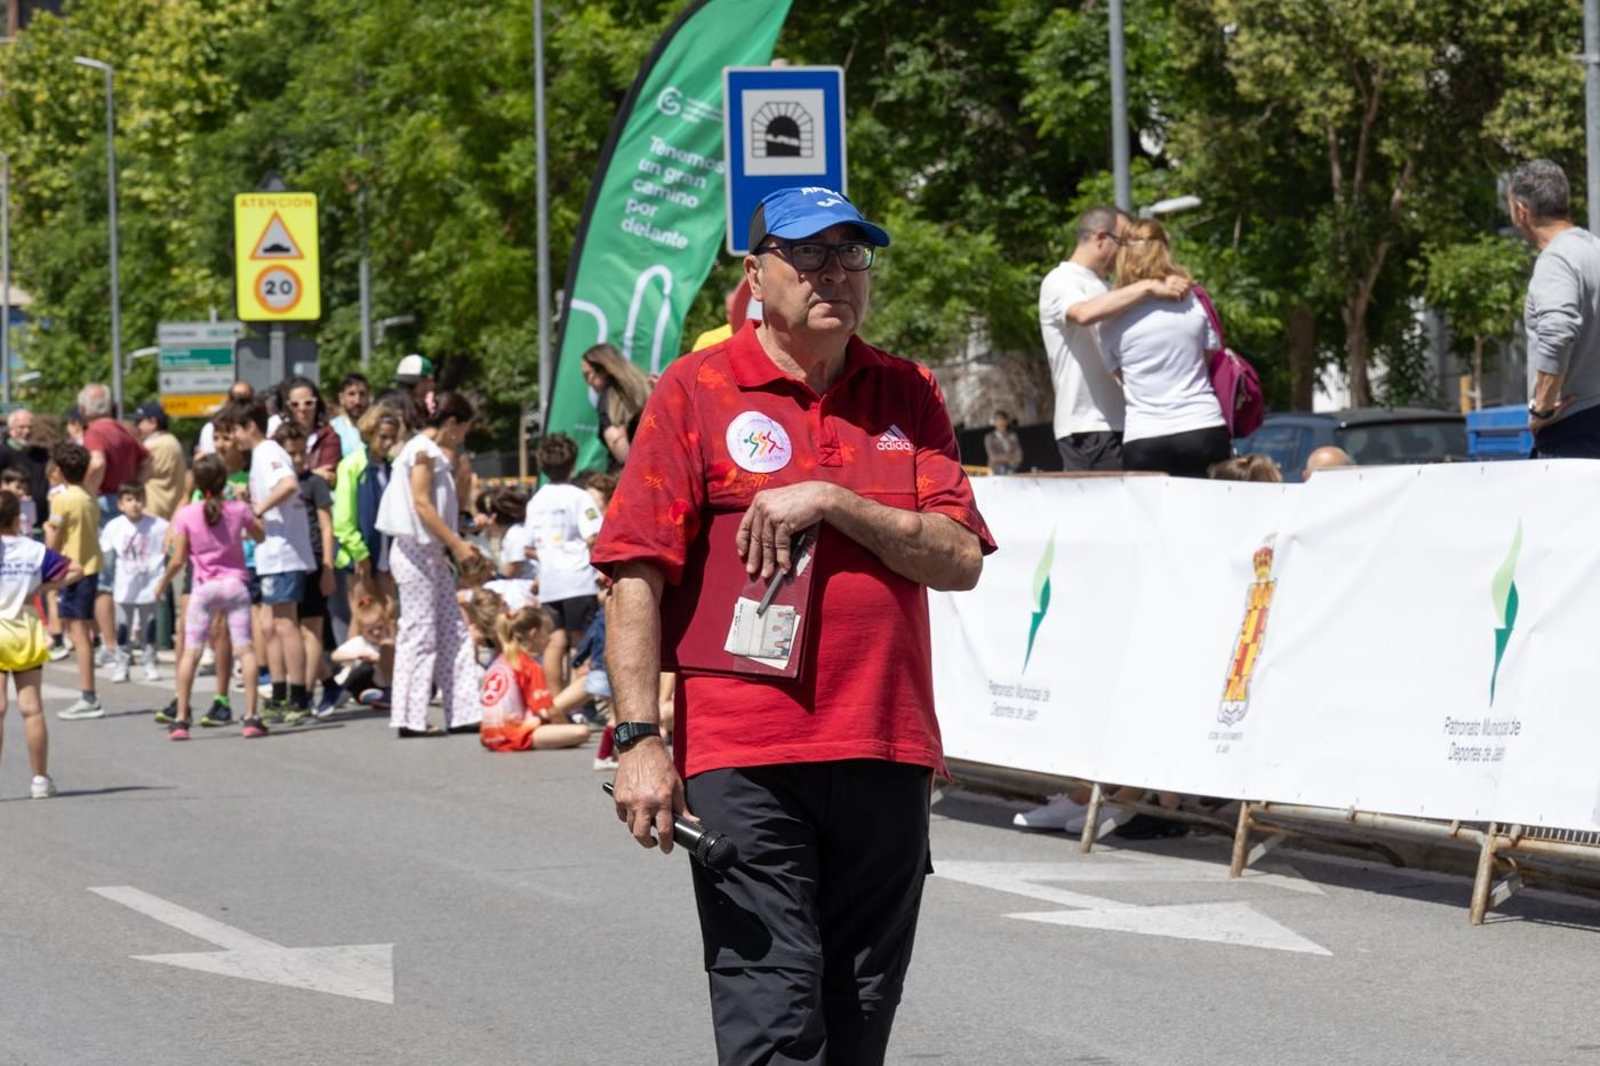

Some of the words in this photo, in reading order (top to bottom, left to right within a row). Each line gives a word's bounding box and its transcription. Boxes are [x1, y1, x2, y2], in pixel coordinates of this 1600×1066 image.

[638, 158, 661, 175] un
[663, 167, 706, 190] gran
[625, 198, 659, 217] por
[632, 178, 699, 209] camino
[621, 217, 688, 249] delante
[264, 280, 293, 296] 20
